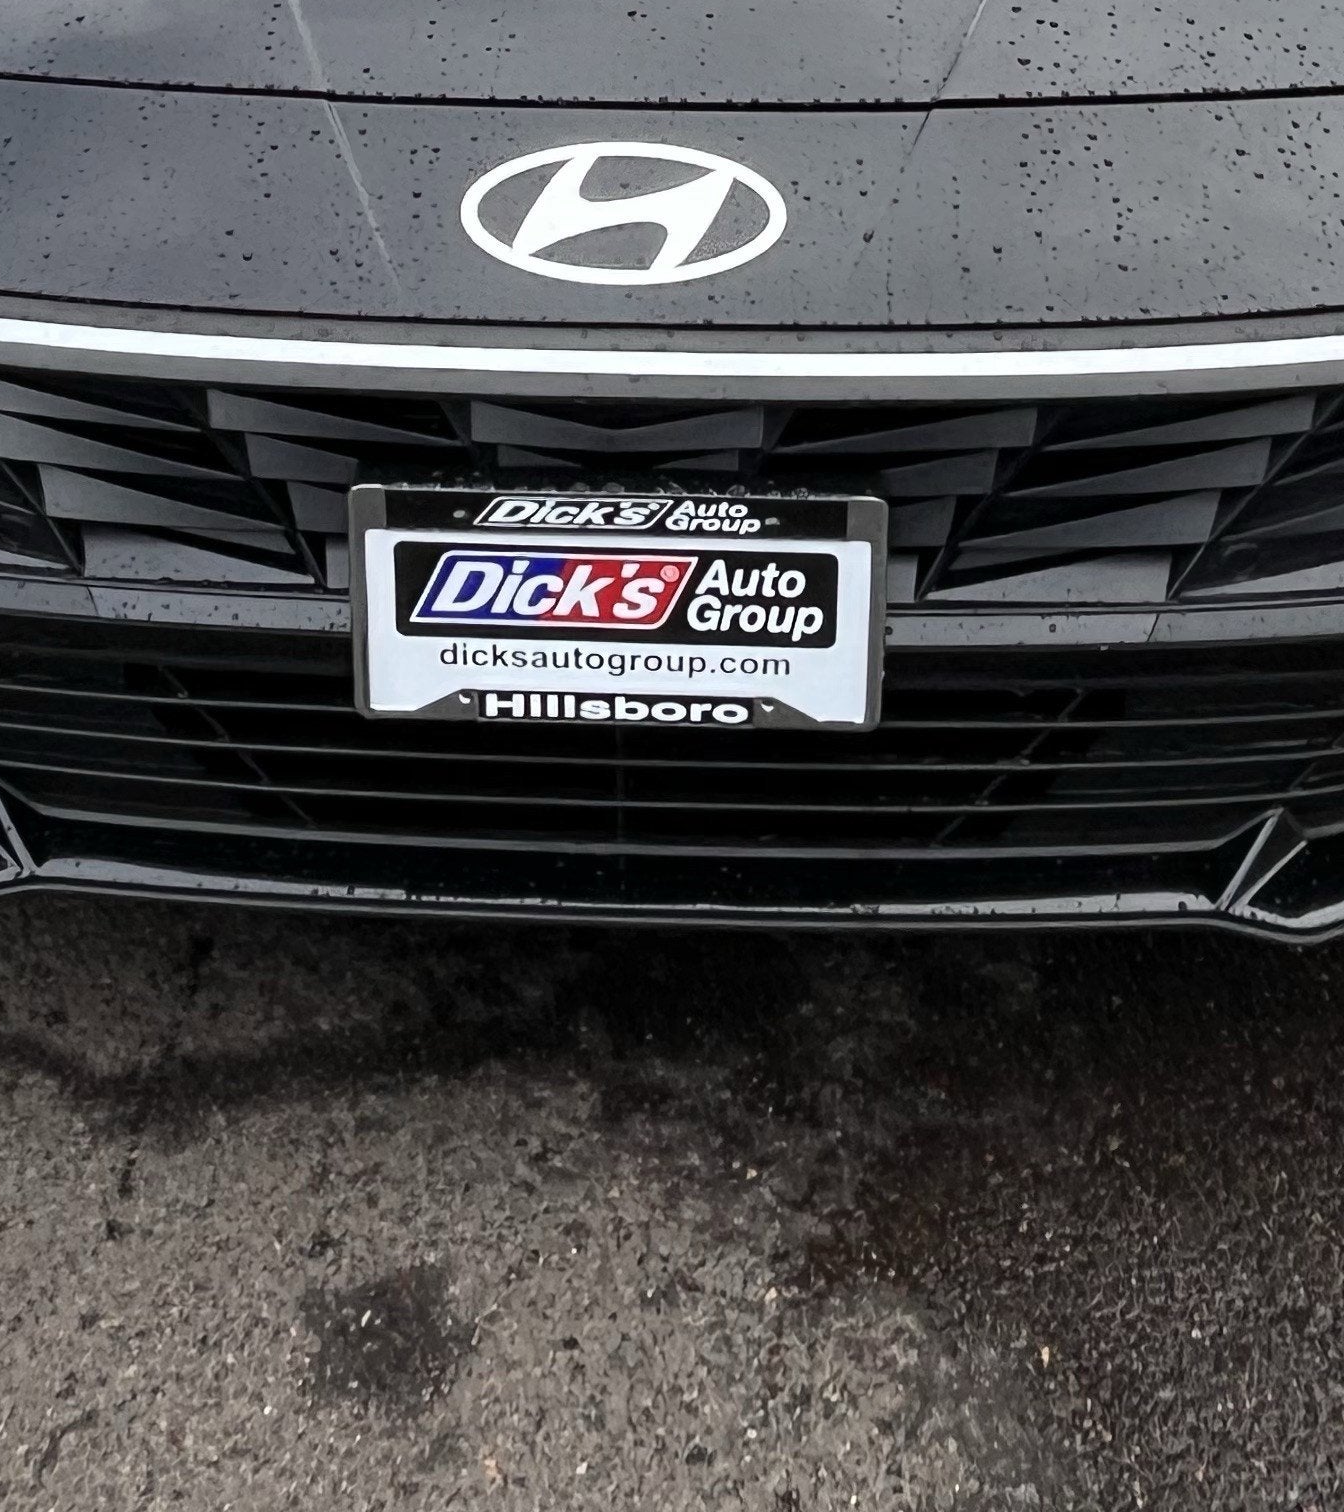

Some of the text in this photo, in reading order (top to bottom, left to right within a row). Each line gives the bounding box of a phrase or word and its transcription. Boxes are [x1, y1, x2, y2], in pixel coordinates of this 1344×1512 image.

[491, 499, 651, 525] Dick's
[669, 500, 749, 518] Auto
[667, 516, 761, 535] Group
[431, 560, 664, 619] Dick's
[694, 559, 806, 598] Auto
[686, 596, 824, 642] Group
[439, 642, 790, 676] dicksautogroup.com
[485, 694, 749, 724] Hillsboro
